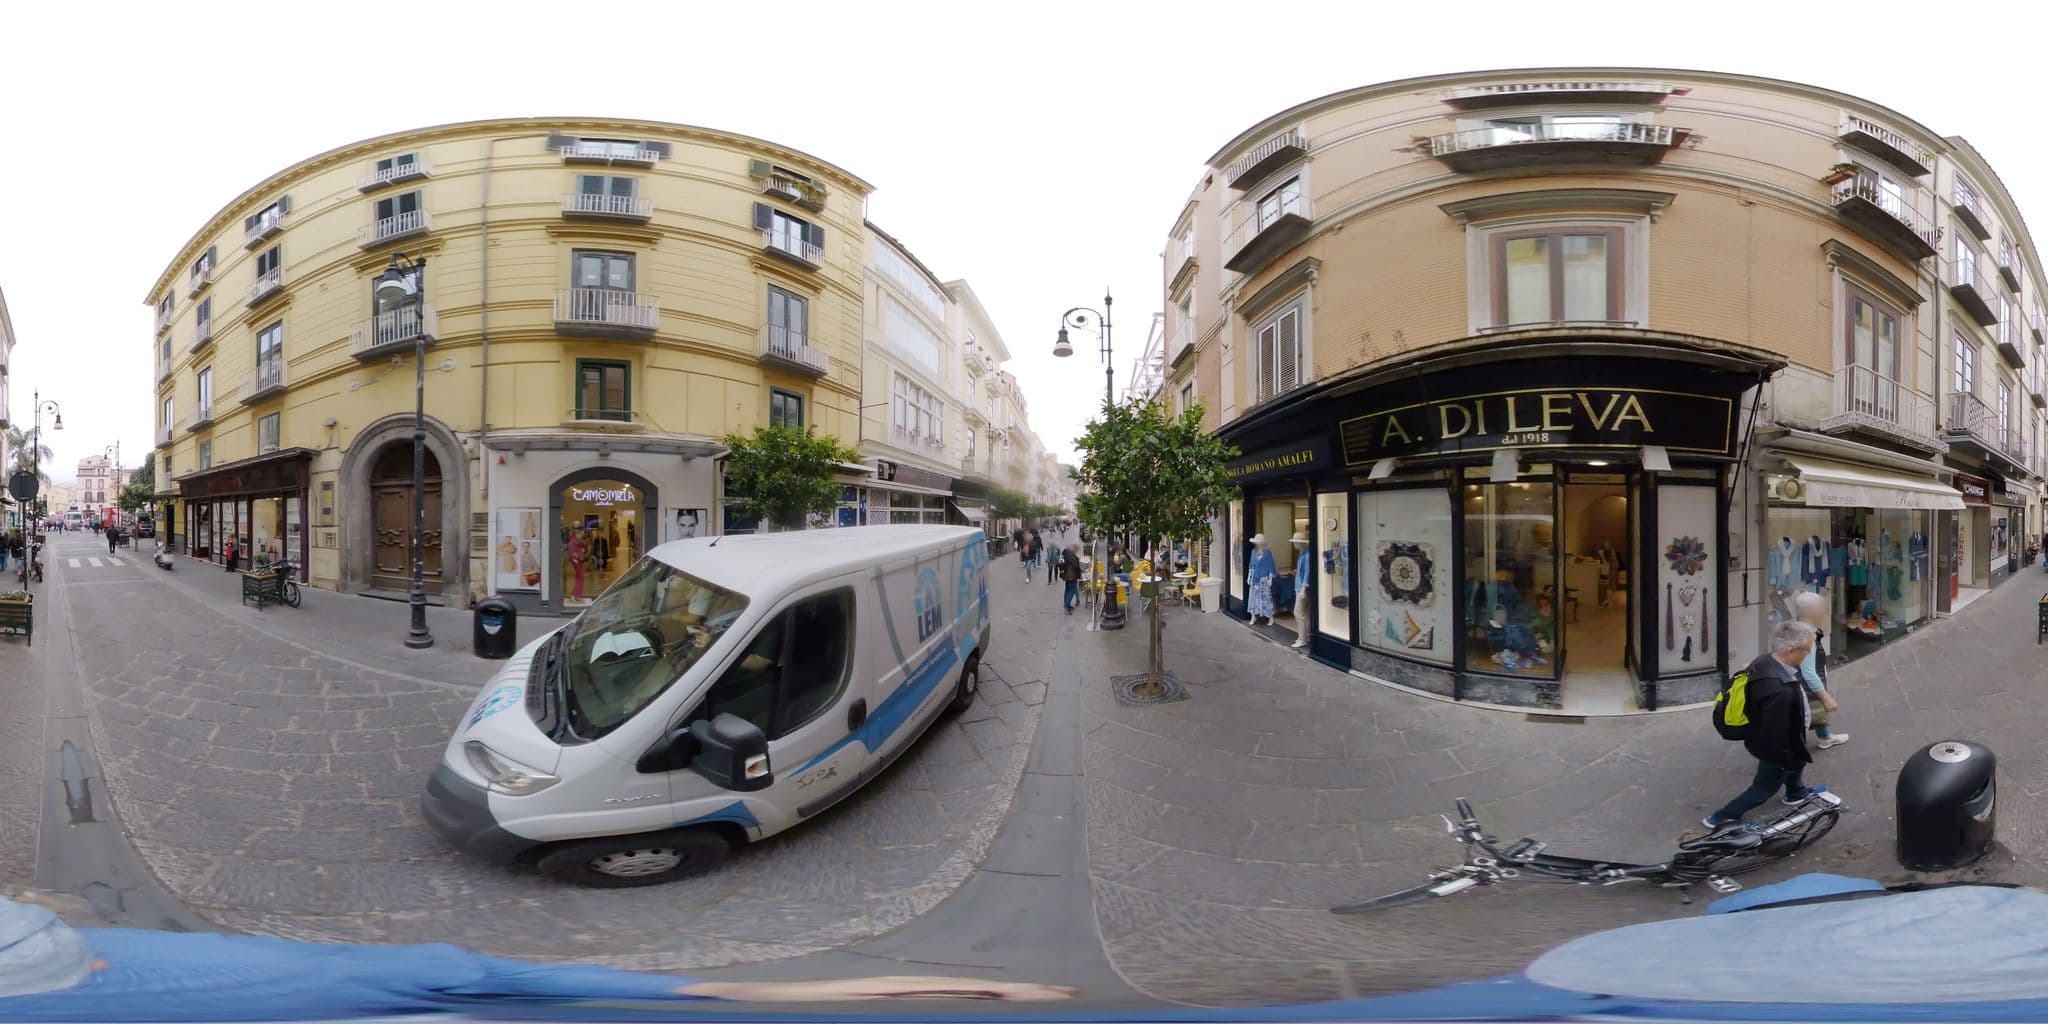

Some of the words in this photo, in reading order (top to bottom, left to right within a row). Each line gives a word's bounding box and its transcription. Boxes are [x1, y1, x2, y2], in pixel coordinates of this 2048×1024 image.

[1381, 415, 1424, 448] A.
[1438, 399, 1488, 440] DI
[1504, 392, 1655, 433] LEVA
[1501, 434, 1518, 444] dal
[1521, 432, 1549, 444] 1918
[1245, 459, 1275, 475] ROMANO
[1277, 449, 1313, 467] AMALFI
[917, 603, 943, 644] LEM
